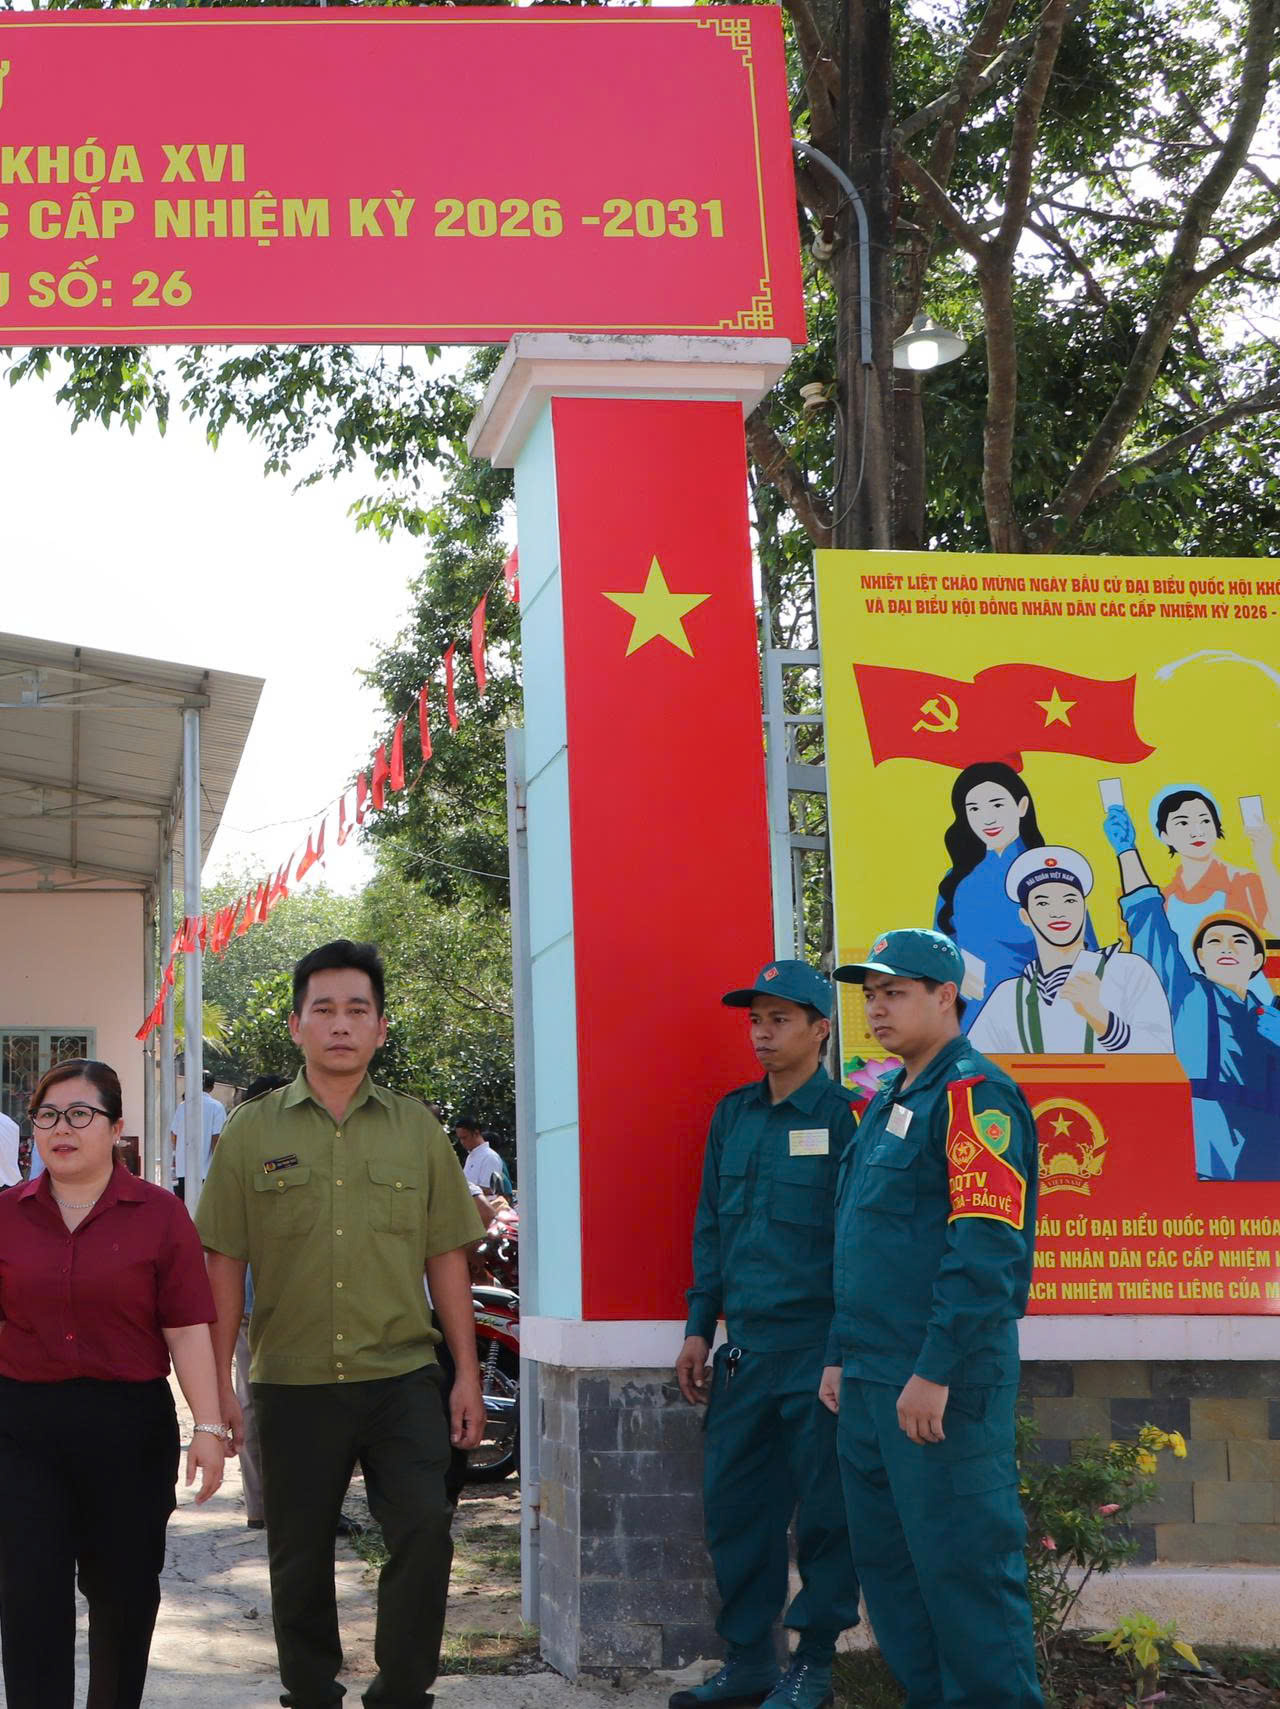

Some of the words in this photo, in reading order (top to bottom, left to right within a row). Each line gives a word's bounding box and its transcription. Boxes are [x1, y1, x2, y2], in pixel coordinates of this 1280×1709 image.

[2, 137, 142, 183] KHÓA
[164, 144, 245, 182] XVI
[29, 187, 135, 239] CẤP
[154, 190, 331, 247] NHIỆM
[350, 190, 415, 237] KỲ
[435, 199, 564, 237] 2026
[28, 255, 112, 307] SỐ:
[131, 270, 193, 306] 26
[860, 573, 903, 593] NHIỆT
[907, 573, 938, 593] LIỆT
[942, 573, 978, 592] CHÀO
[982, 574, 1026, 592] MỪNG
[1029, 575, 1068, 593] NGÀY
[1071, 573, 1100, 593] BẦU
[1103, 575, 1121, 593] CỬ
[1126, 579, 1150, 597] ĐẠI
[1153, 574, 1185, 595] BIỂU
[1189, 576, 1224, 597] QUỐC
[1228, 579, 1252, 598] HỘI
[865, 597, 885, 614] VÀ
[888, 599, 912, 616] ĐẠI
[916, 594, 948, 614] BIỂU
[952, 597, 976, 617] HỘI
[979, 596, 1018, 615] ĐỒNG
[1022, 599, 1063, 616] NHÂN
[1066, 599, 1096, 617] DÂN
[1100, 601, 1126, 617] CÁC
[1129, 599, 1156, 618] CẤP
[1160, 601, 1208, 621] NHIỆM
[1211, 601, 1230, 619] KỲ
[1234, 604, 1268, 619] 2026
[1065, 1213, 1088, 1237] CỬ
[1091, 1219, 1118, 1240] ĐẠI
[1122, 1212, 1158, 1237] BIỂU
[1162, 1212, 1205, 1238] QUỐC
[1209, 1215, 1236, 1240] HỘI
[1240, 1215, 1280, 1236] KHÓA
[1033, 1250, 1056, 1268] NG
[1060, 1247, 1104, 1268] NHÂN
[1109, 1247, 1141, 1268] DÂN
[1146, 1247, 1178, 1268] CÁC
[1182, 1244, 1214, 1268] CẤP
[1218, 1246, 1271, 1272] NHIỆM
[1061, 1278, 1113, 1304] NHIỆM
[1117, 1278, 1174, 1300] THIÊNG
[1178, 1278, 1224, 1300] LIÊNG
[1228, 1275, 1261, 1300] CỦA
